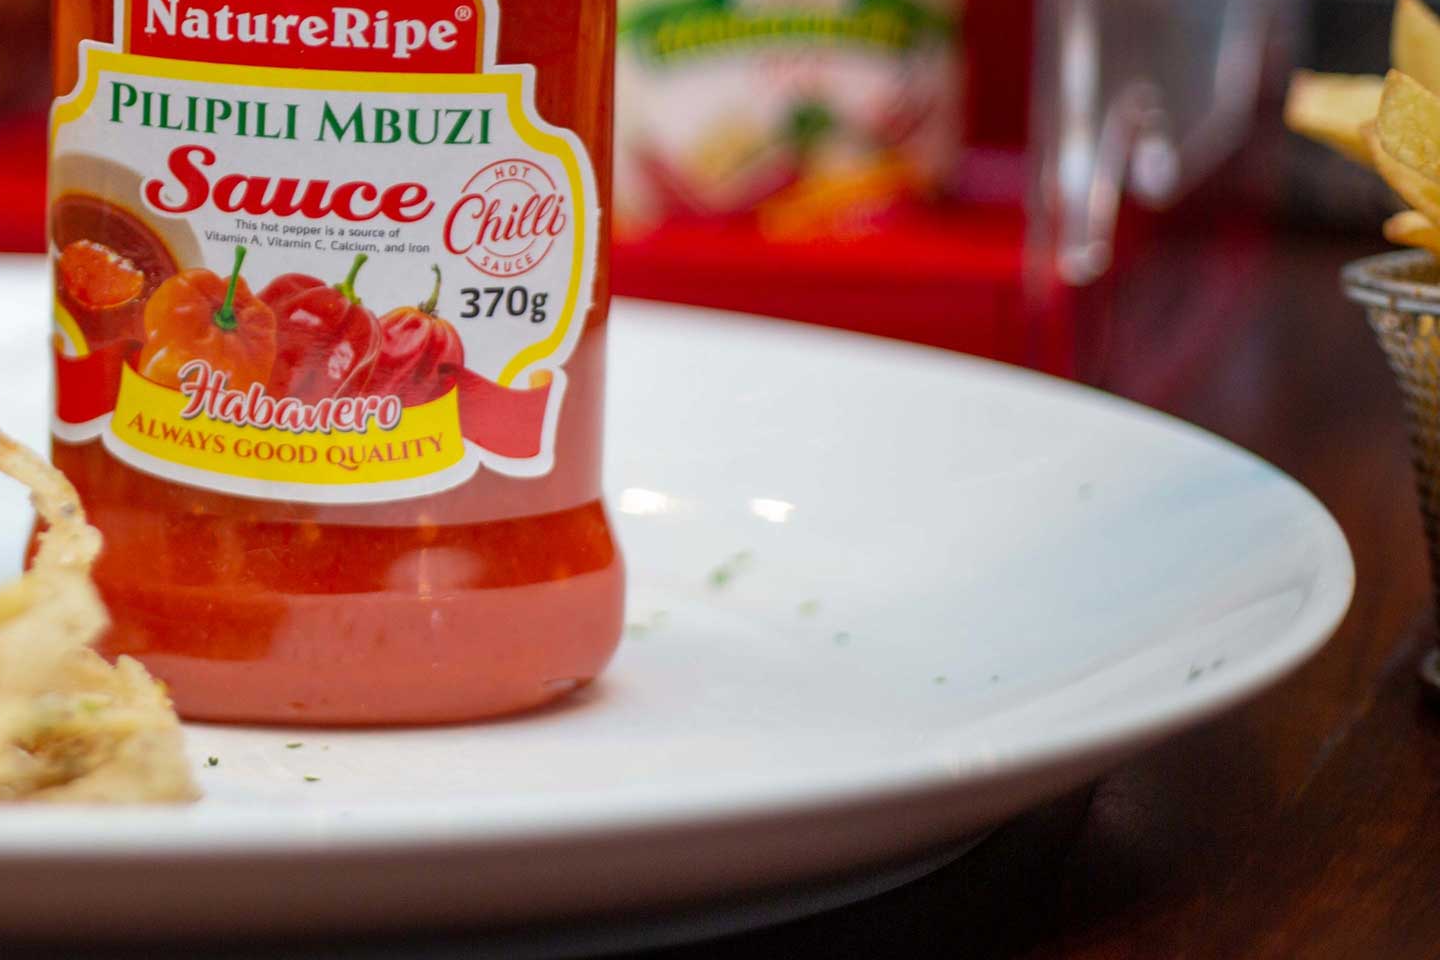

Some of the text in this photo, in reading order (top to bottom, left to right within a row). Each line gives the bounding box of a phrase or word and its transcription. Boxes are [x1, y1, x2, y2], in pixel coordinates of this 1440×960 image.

[109, 81, 493, 145] PILIPILI MBUZI
[145, 144, 435, 223] Sauce
[494, 165, 531, 179] HOT
[205, 230, 247, 244] Vitamin
[267, 235, 311, 249] Vitamin
[383, 242, 405, 253] and
[235, 218, 401, 238] This hot pepper is a source of
[443, 193, 566, 255] Chilli
[481, 253, 534, 272] SAUCE
[460, 286, 548, 323] 370g
[178, 359, 402, 432] Habanero
[128, 411, 444, 470] ALWAYS GOOD QUALITY
